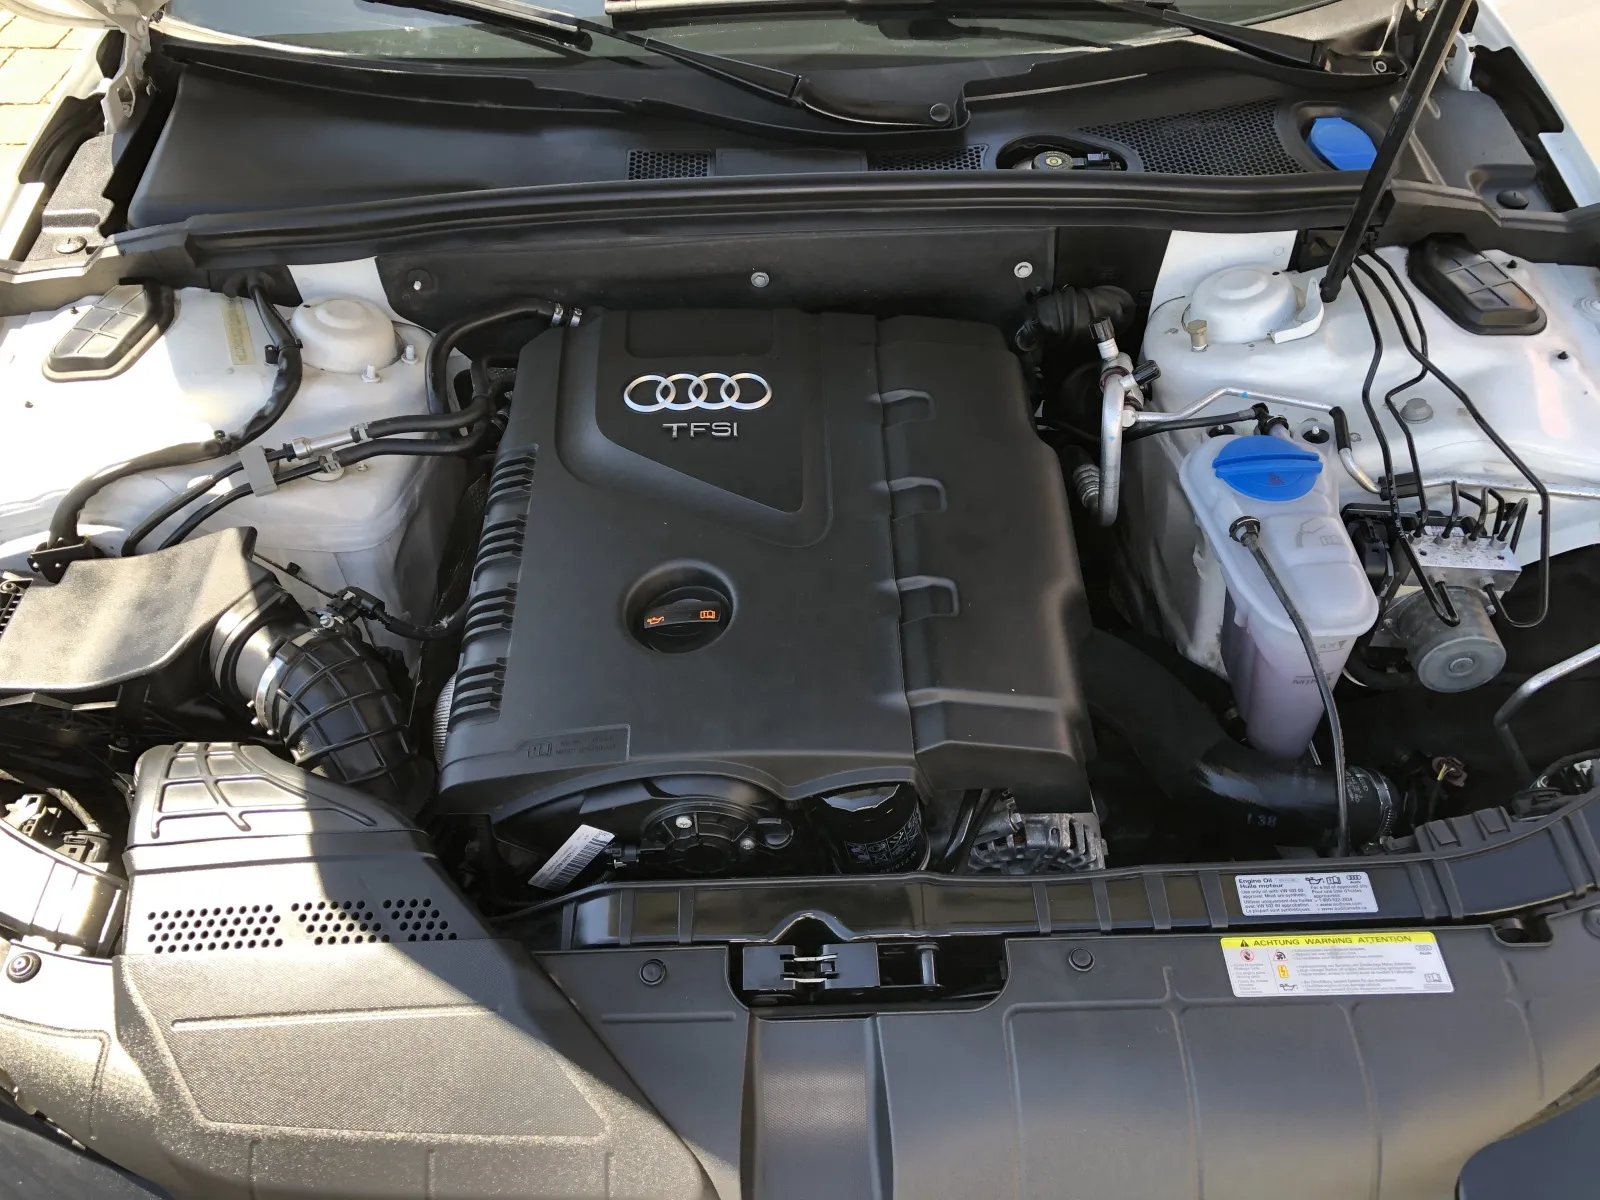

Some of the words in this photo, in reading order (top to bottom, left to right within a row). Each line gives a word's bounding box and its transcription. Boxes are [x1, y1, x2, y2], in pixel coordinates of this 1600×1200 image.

[662, 422, 738, 438] TFSI
[1253, 938, 1300, 946] ACHTUNG
[1304, 937, 1353, 945] WARNING
[1358, 935, 1412, 944] ATTENTION
